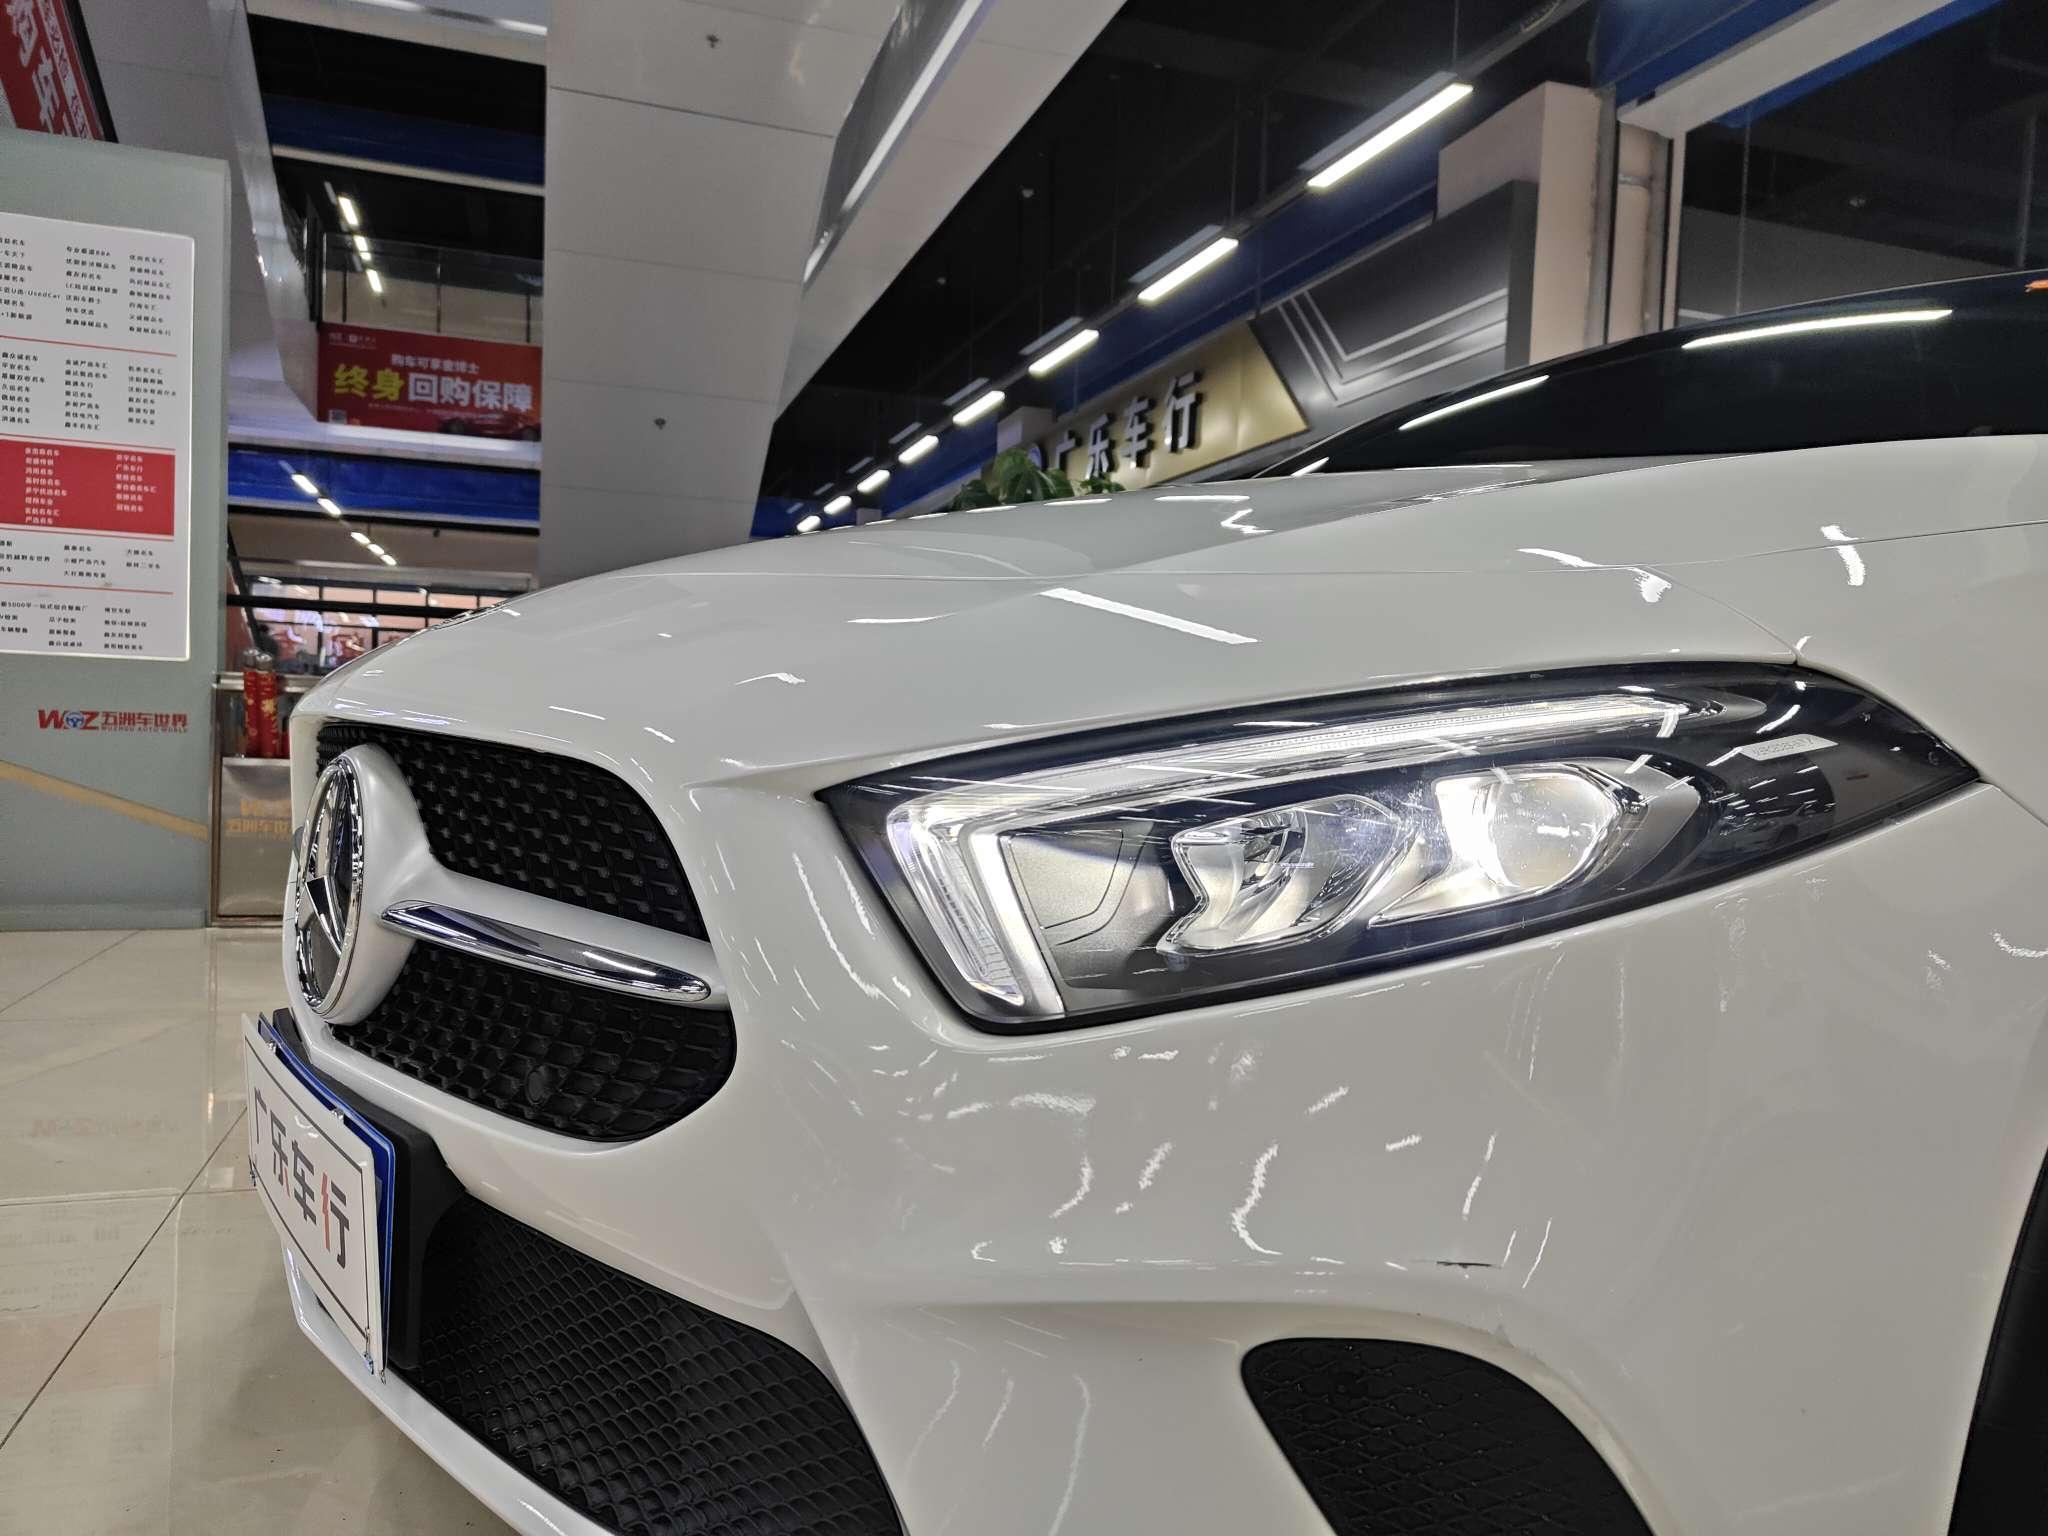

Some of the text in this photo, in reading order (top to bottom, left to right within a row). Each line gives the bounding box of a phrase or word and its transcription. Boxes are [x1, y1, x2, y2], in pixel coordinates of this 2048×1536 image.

[334, 363, 533, 413] 终身回购保障
[1055, 373, 1196, 479] 广乐车行
[101, 711, 189, 728] 五洲车世界
[254, 1087, 350, 1270] 广乐车行
